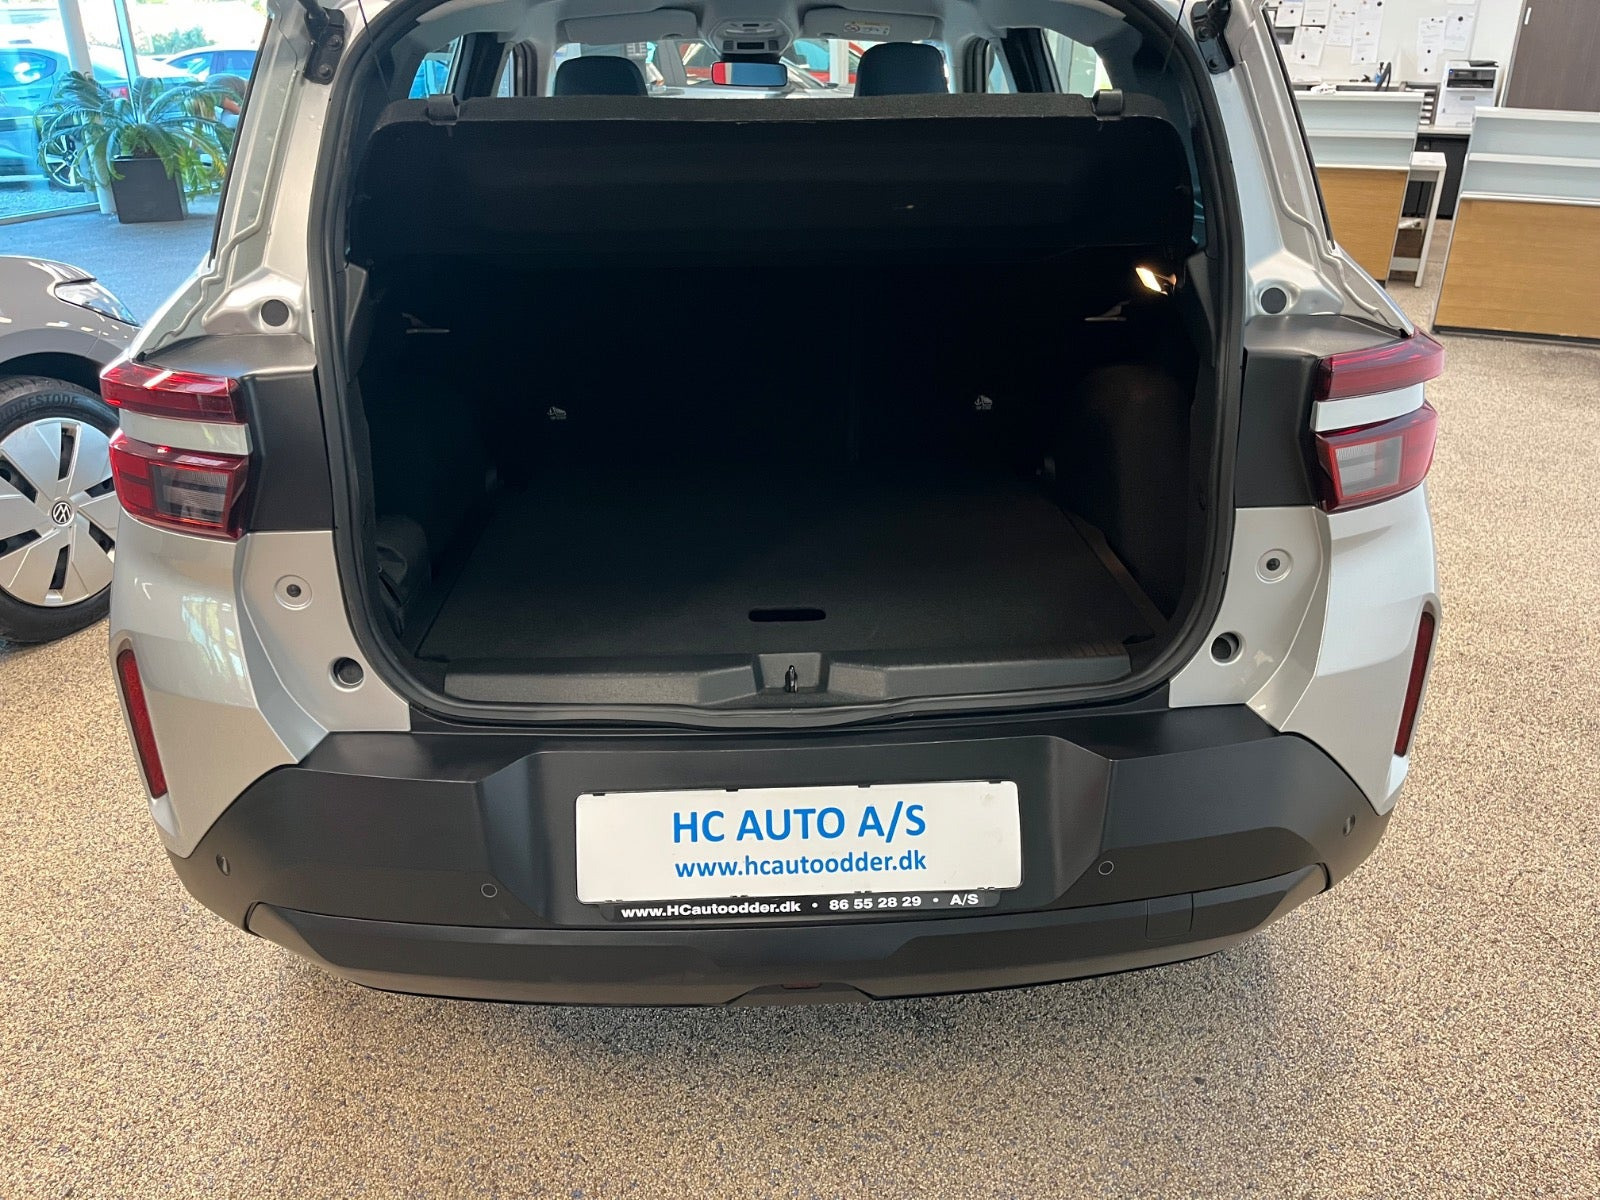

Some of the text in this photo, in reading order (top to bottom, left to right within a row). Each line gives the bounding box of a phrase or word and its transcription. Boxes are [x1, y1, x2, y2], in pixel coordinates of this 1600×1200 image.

[673, 801, 926, 843] HC AUTO A/S
[675, 850, 927, 878] www.hcautoodder.dk
[621, 893, 979, 918] www.HCautoodder.dk 86 55 28 29 A/S
